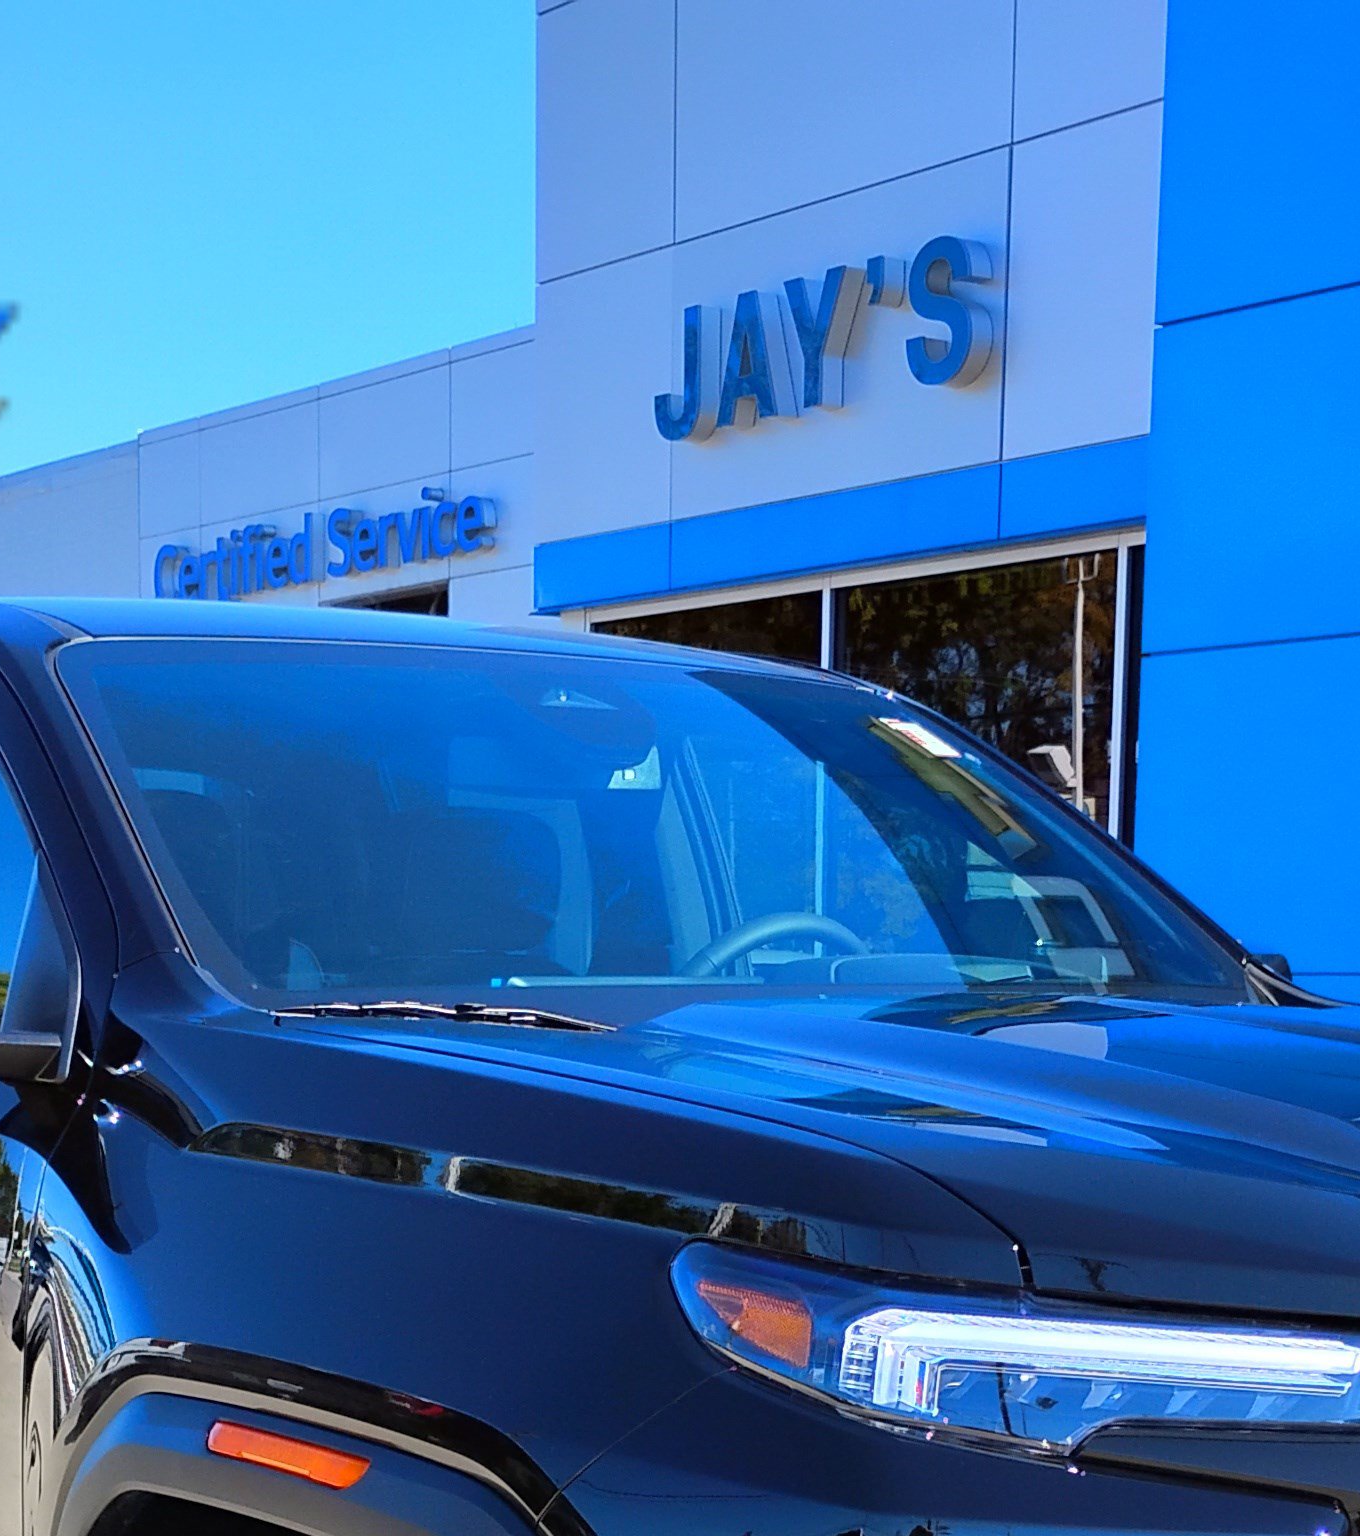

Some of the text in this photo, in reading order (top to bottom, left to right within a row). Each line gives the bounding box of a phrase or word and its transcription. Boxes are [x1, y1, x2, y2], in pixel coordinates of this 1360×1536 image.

[654, 235, 992, 443] JAY'S
[154, 487, 492, 600] Certified Service
